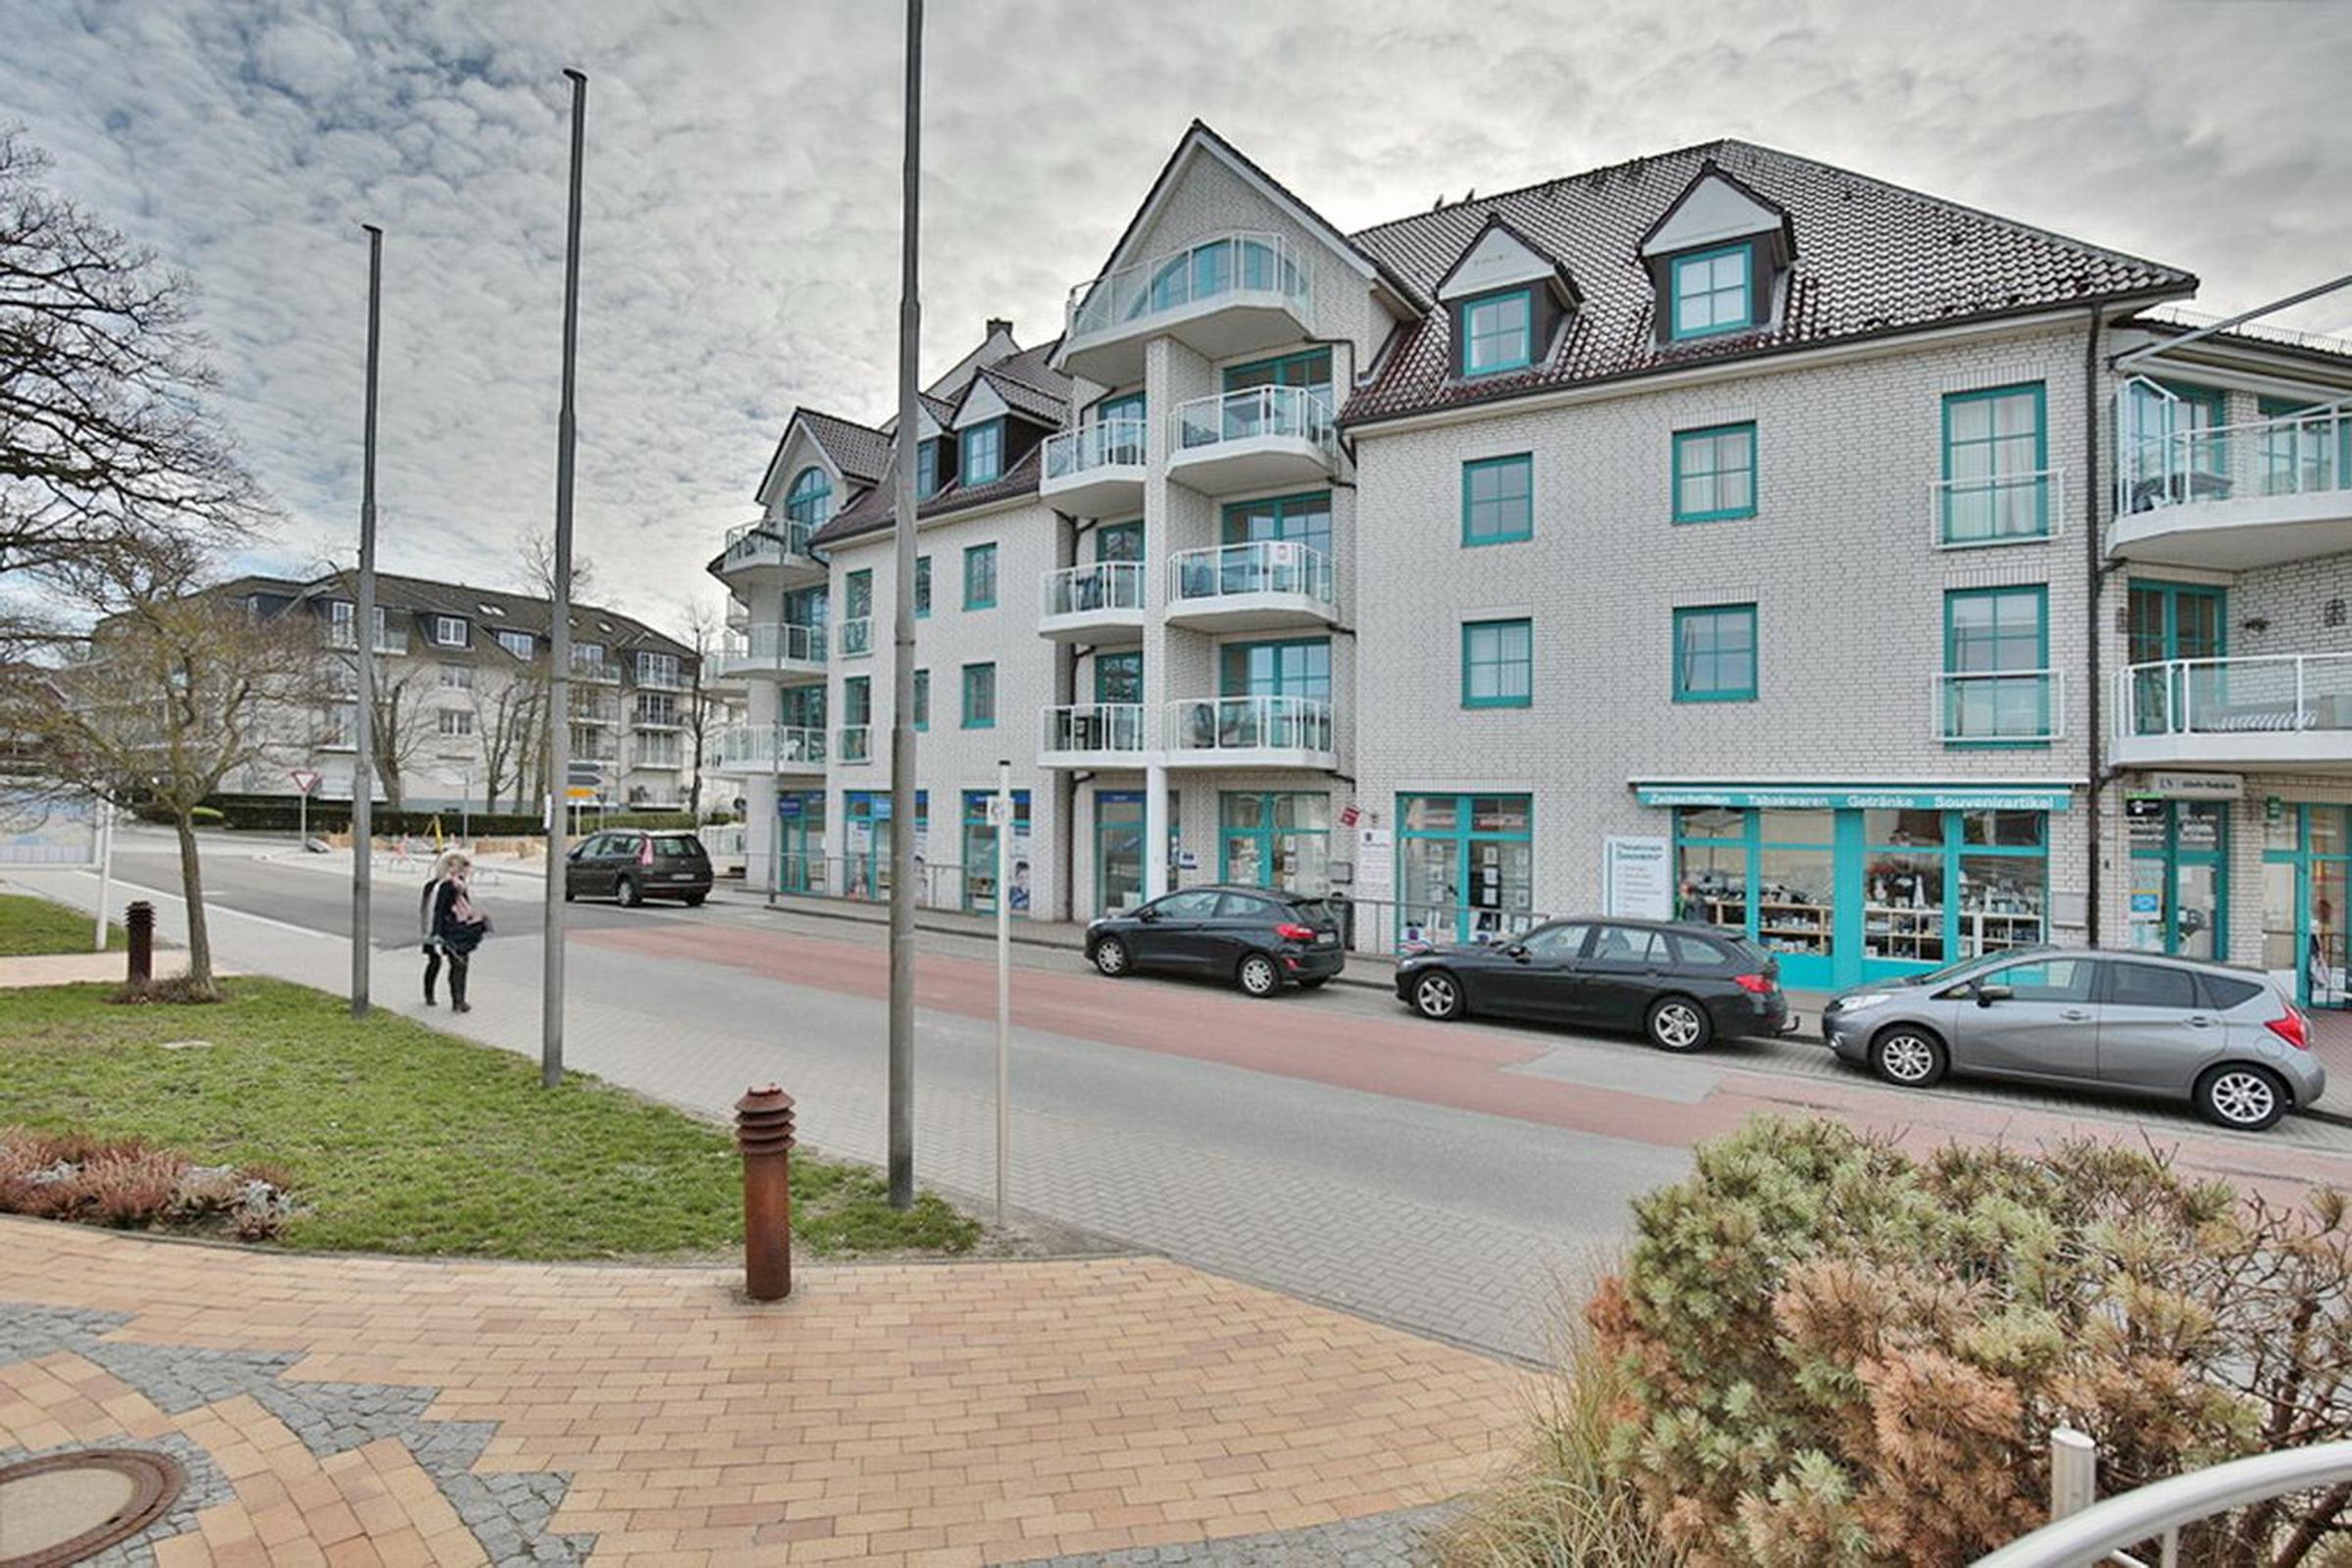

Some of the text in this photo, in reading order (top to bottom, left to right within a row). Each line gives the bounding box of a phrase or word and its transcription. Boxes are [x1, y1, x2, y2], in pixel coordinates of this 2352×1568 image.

[1648, 794, 2054, 808] Zeitschriften Tabakwaren Getränke Souvenirartikel
